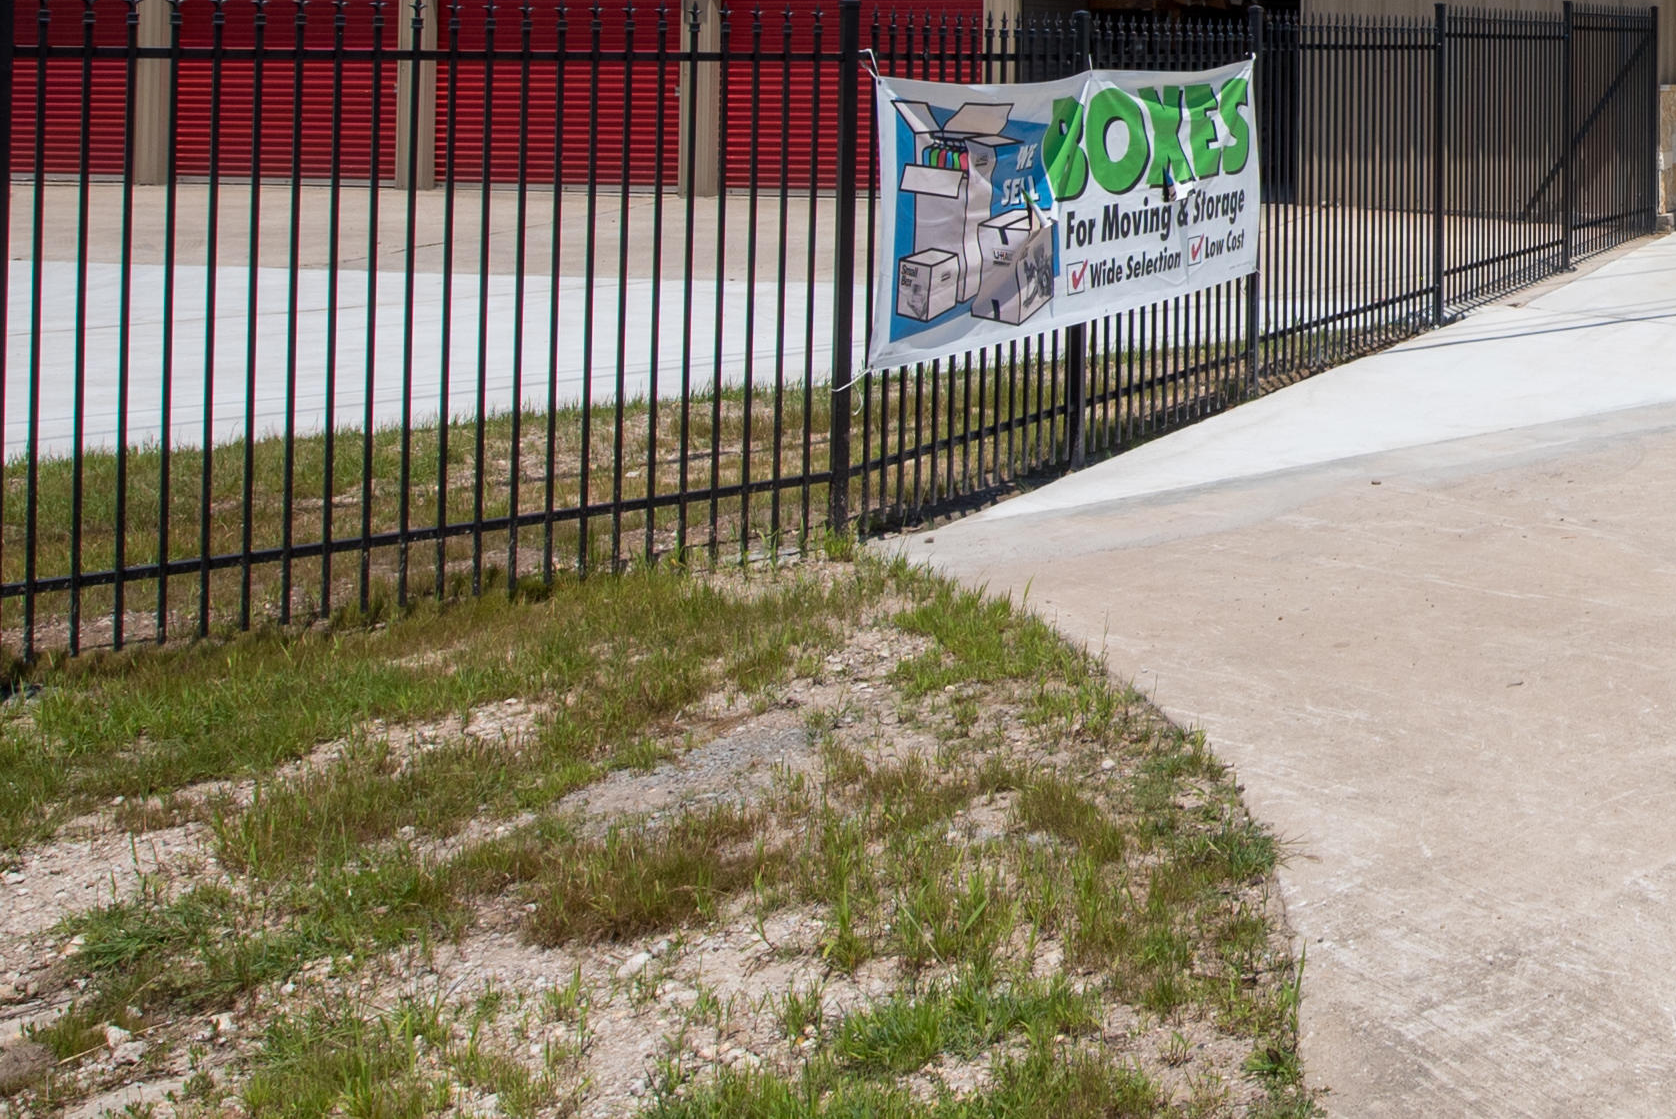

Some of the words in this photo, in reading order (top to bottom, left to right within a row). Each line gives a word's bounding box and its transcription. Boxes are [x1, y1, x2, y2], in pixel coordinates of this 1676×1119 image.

[1041, 78, 1250, 202] BOXES
[1016, 143, 1039, 172] WE
[1001, 175, 1041, 207] SELL
[1065, 210, 1096, 250] For
[1100, 196, 1172, 242] Moving
[1176, 196, 1189, 228] &
[1192, 188, 1245, 225] Storage
[1204, 236, 1225, 260] Low
[1226, 228, 1245, 252] Cost
[901, 263, 919, 278] Small
[1089, 259, 1123, 289] Wide
[1126, 246, 1182, 282] Selection
